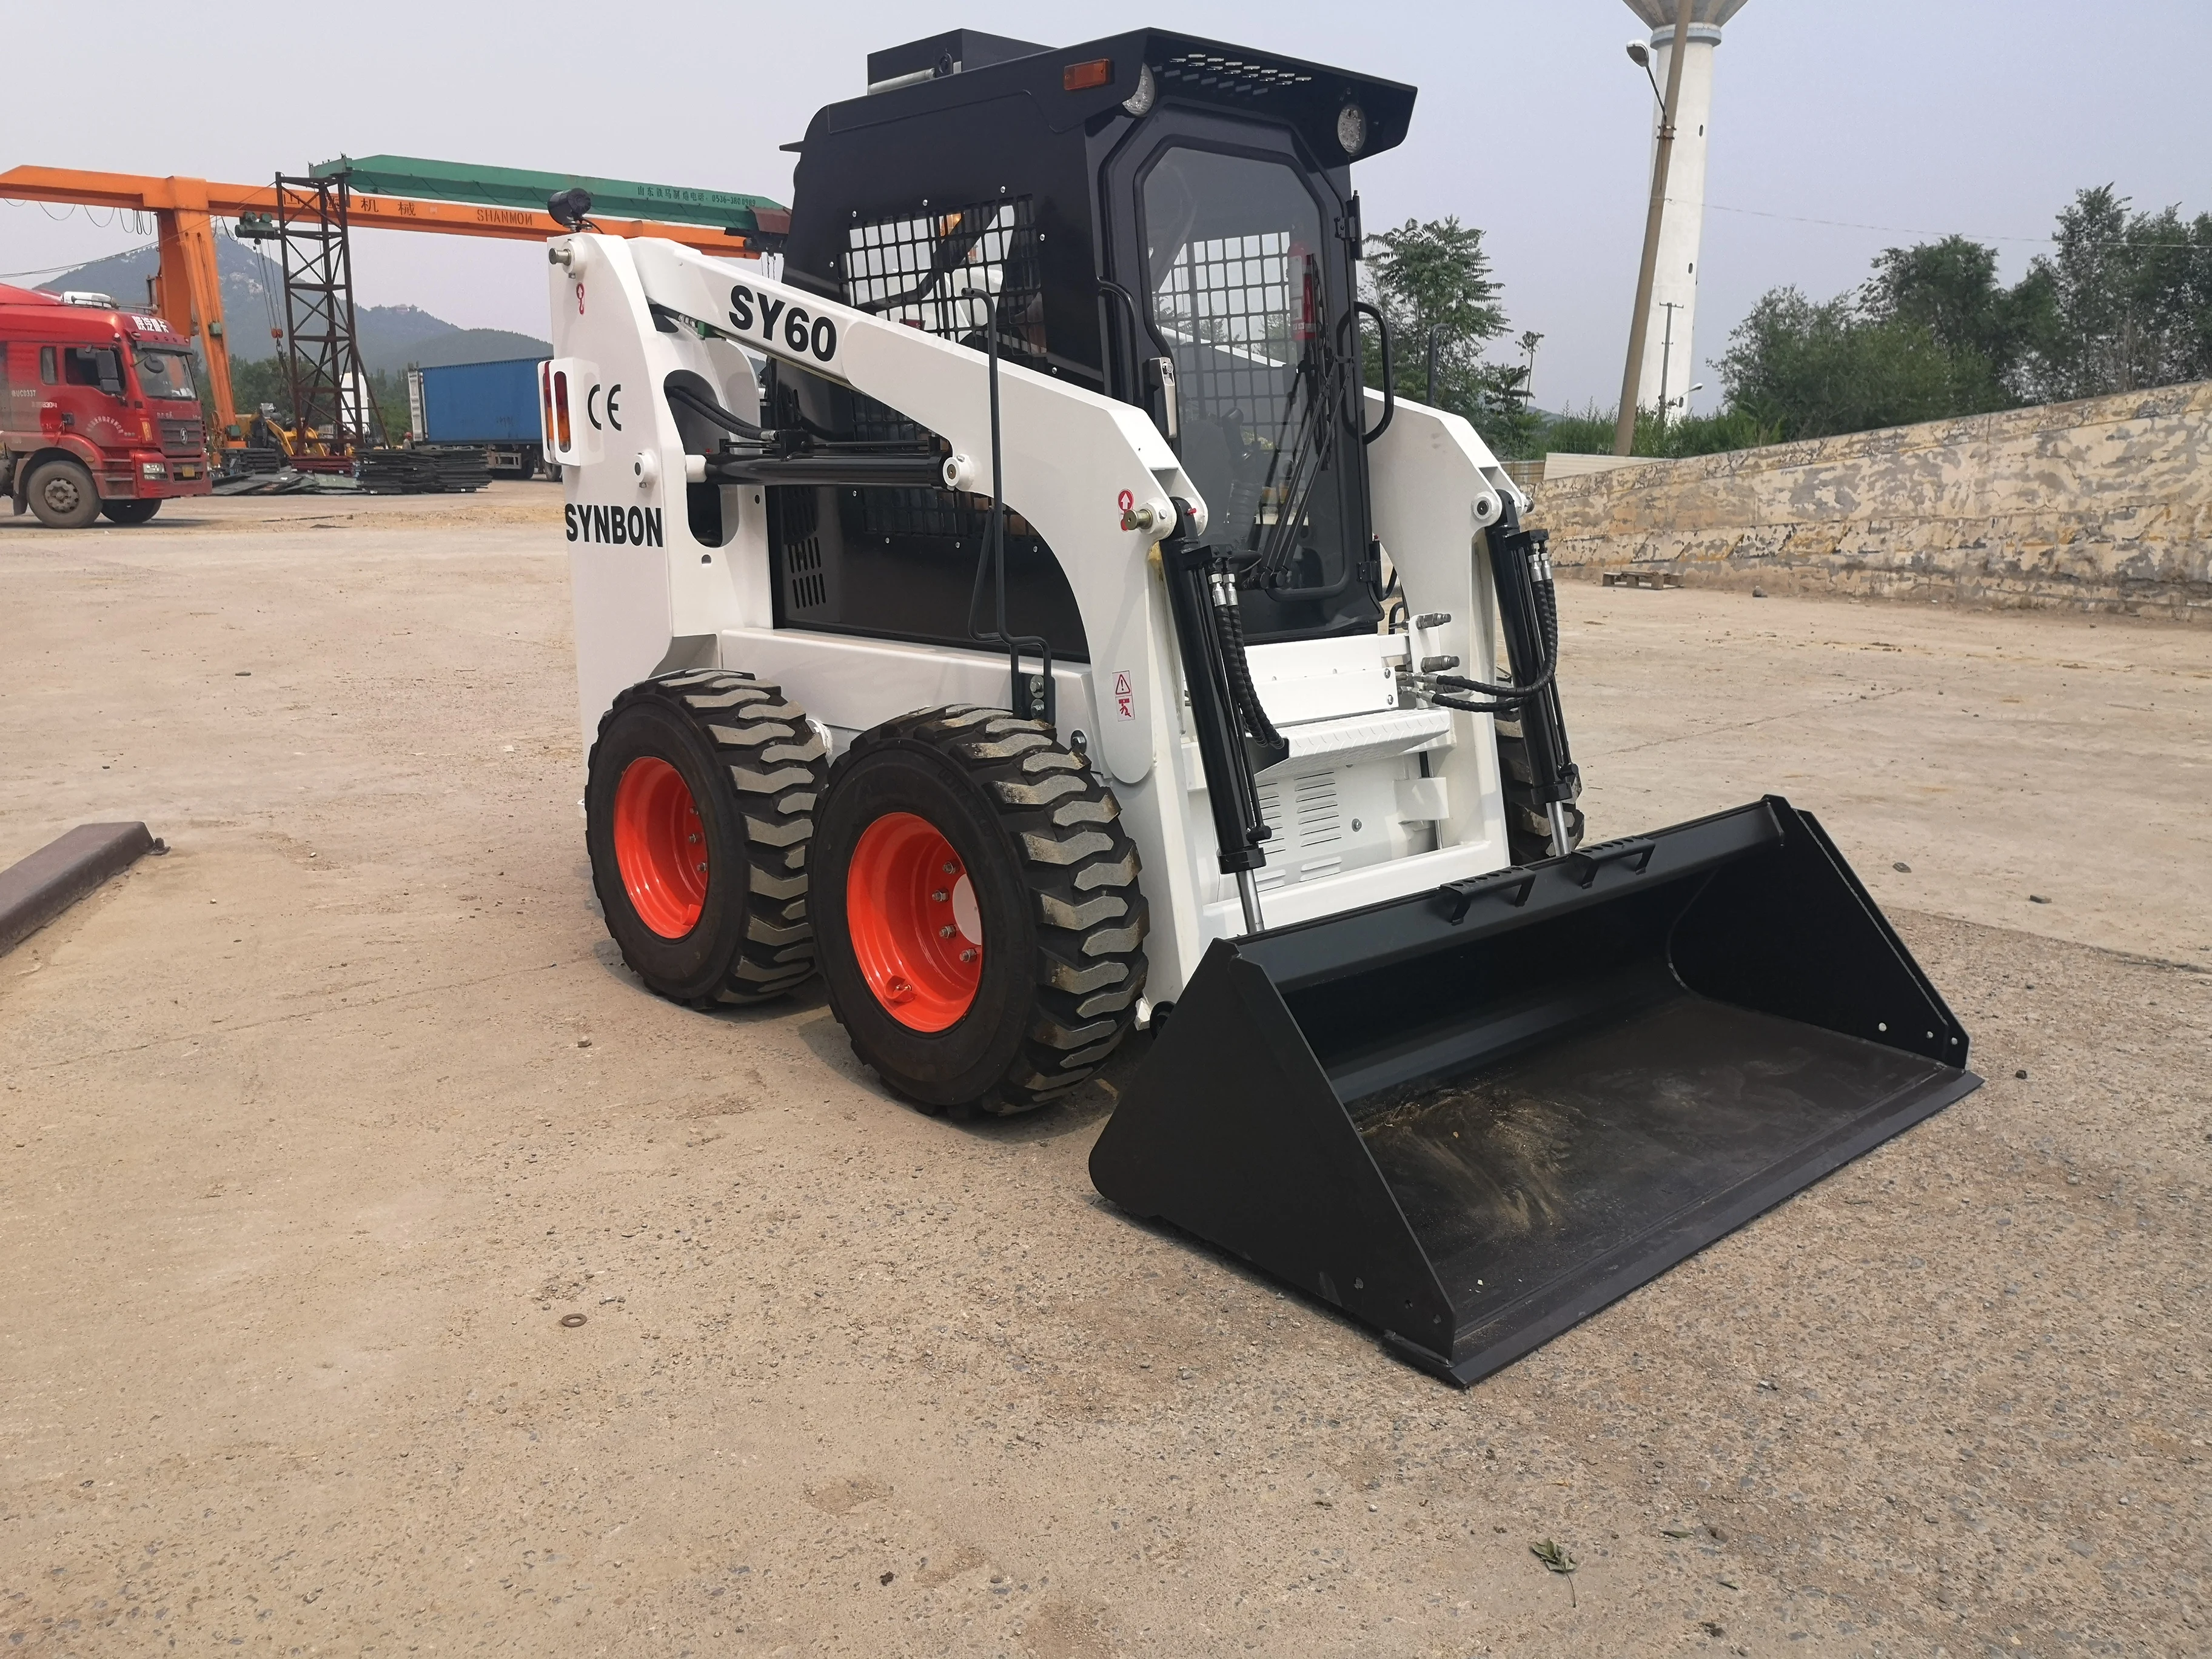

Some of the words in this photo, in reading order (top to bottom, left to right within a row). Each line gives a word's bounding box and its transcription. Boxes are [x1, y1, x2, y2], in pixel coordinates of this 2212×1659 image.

[729, 285, 837, 362] SY60
[588, 384, 622, 431] CE
[565, 503, 663, 548] SYNBON
